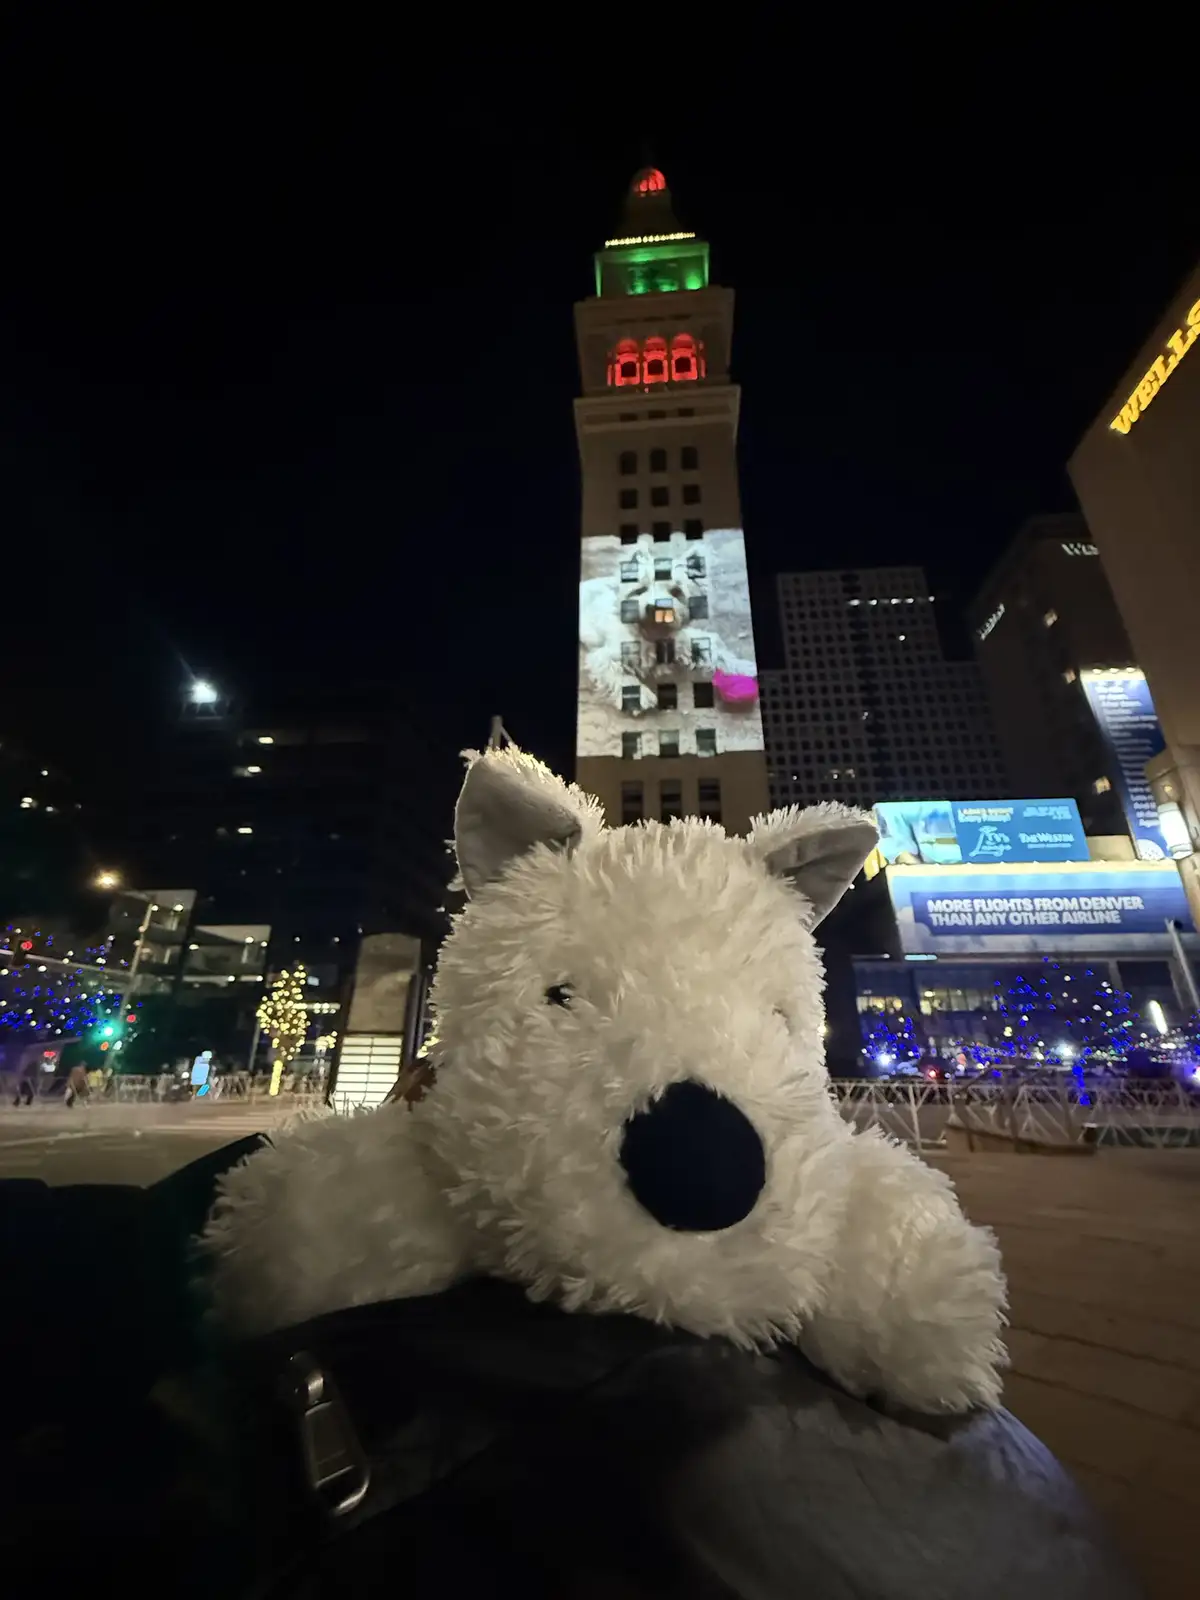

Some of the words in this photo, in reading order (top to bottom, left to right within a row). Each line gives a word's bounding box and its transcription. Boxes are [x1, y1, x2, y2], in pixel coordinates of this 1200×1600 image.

[928, 899, 972, 913] MORE
[974, 898, 1033, 912] FLIGHTS
[1034, 897, 1080, 911] FROM
[1080, 896, 1144, 910] DENVER
[929, 912, 972, 926] THAN
[975, 911, 1007, 926] ANY
[1009, 911, 1060, 925] OTHER
[1062, 910, 1121, 924] AIRLINE
